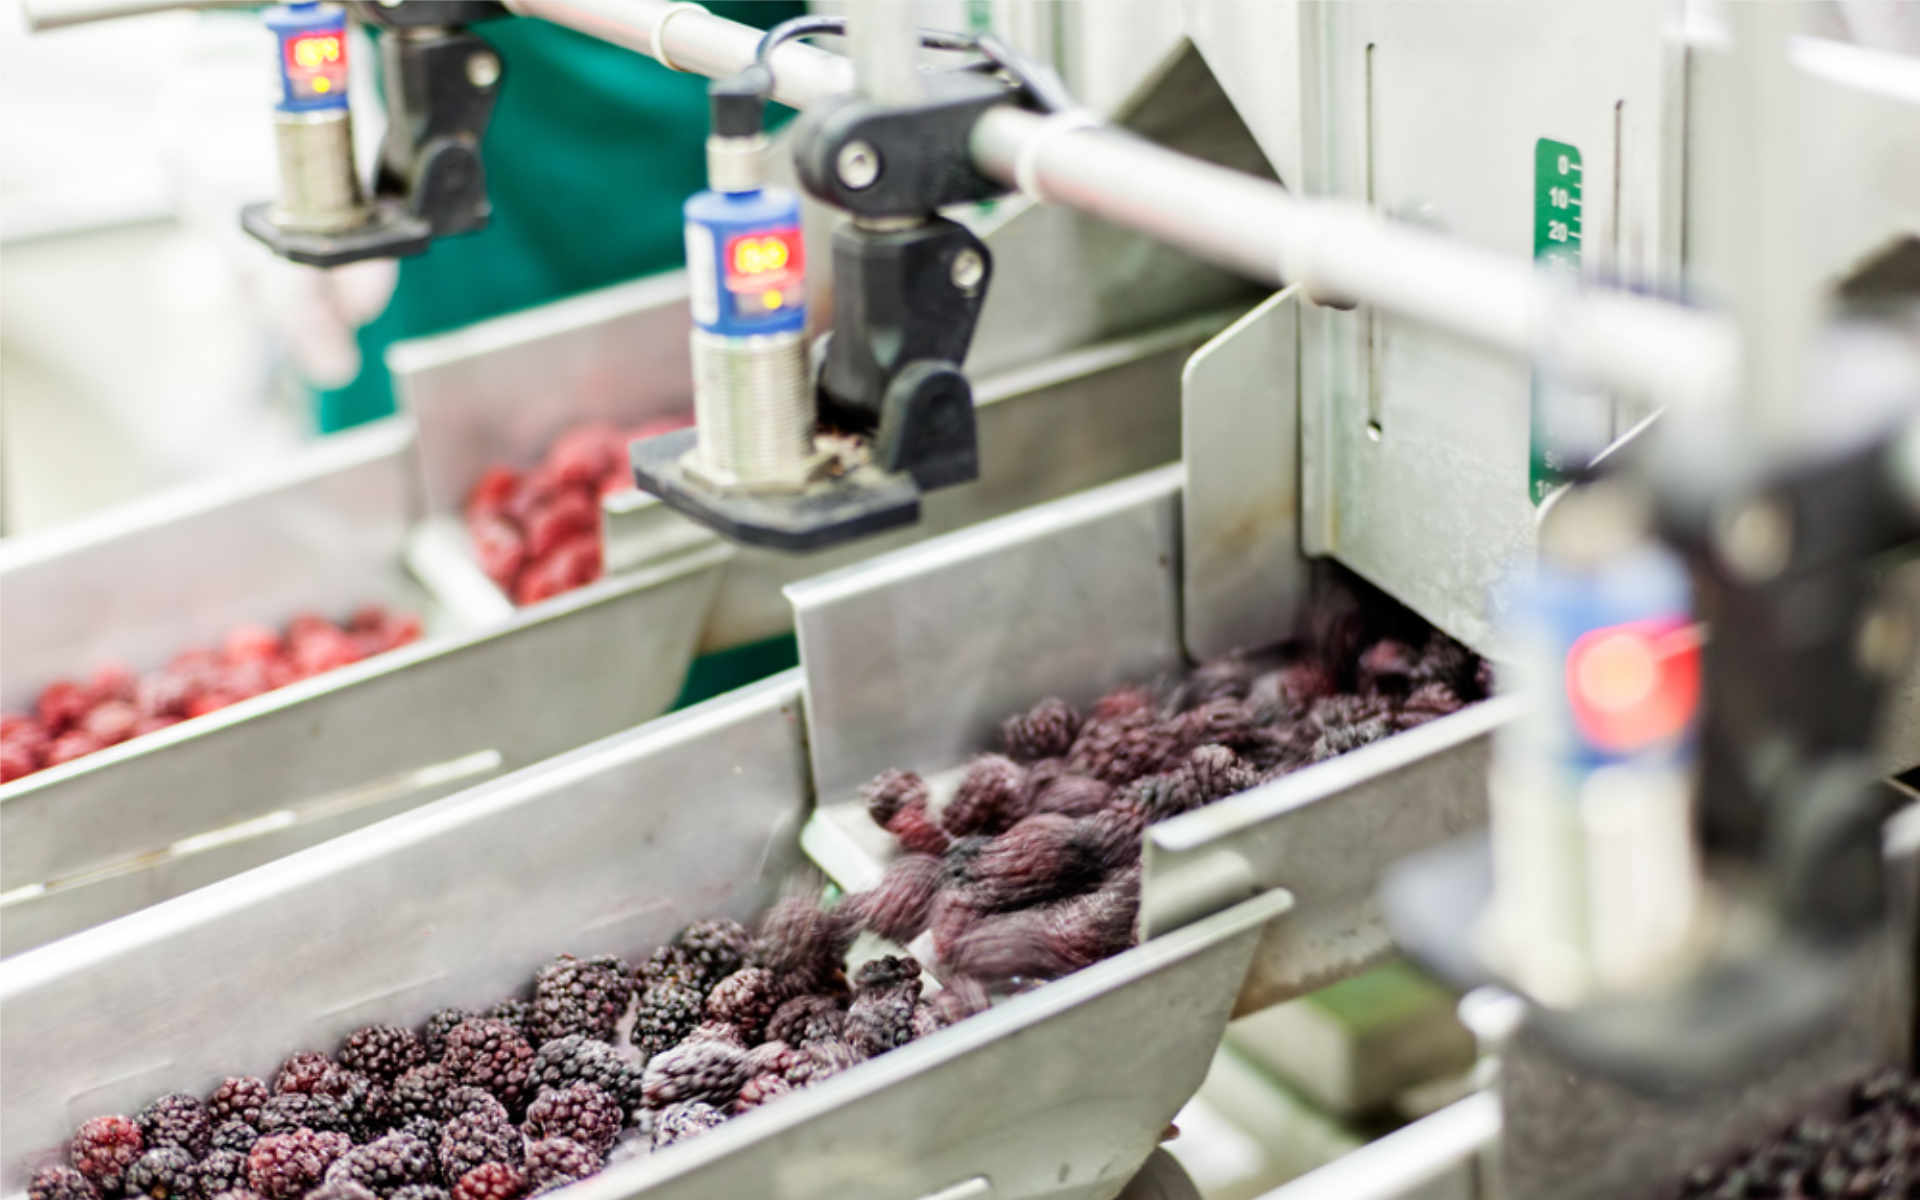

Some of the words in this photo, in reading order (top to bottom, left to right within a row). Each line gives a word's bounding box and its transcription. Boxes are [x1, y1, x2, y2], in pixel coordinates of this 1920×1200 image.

[1558, 155, 1569, 175] 0
[1549, 187, 1569, 209] 10
[1548, 220, 1569, 242] 20
